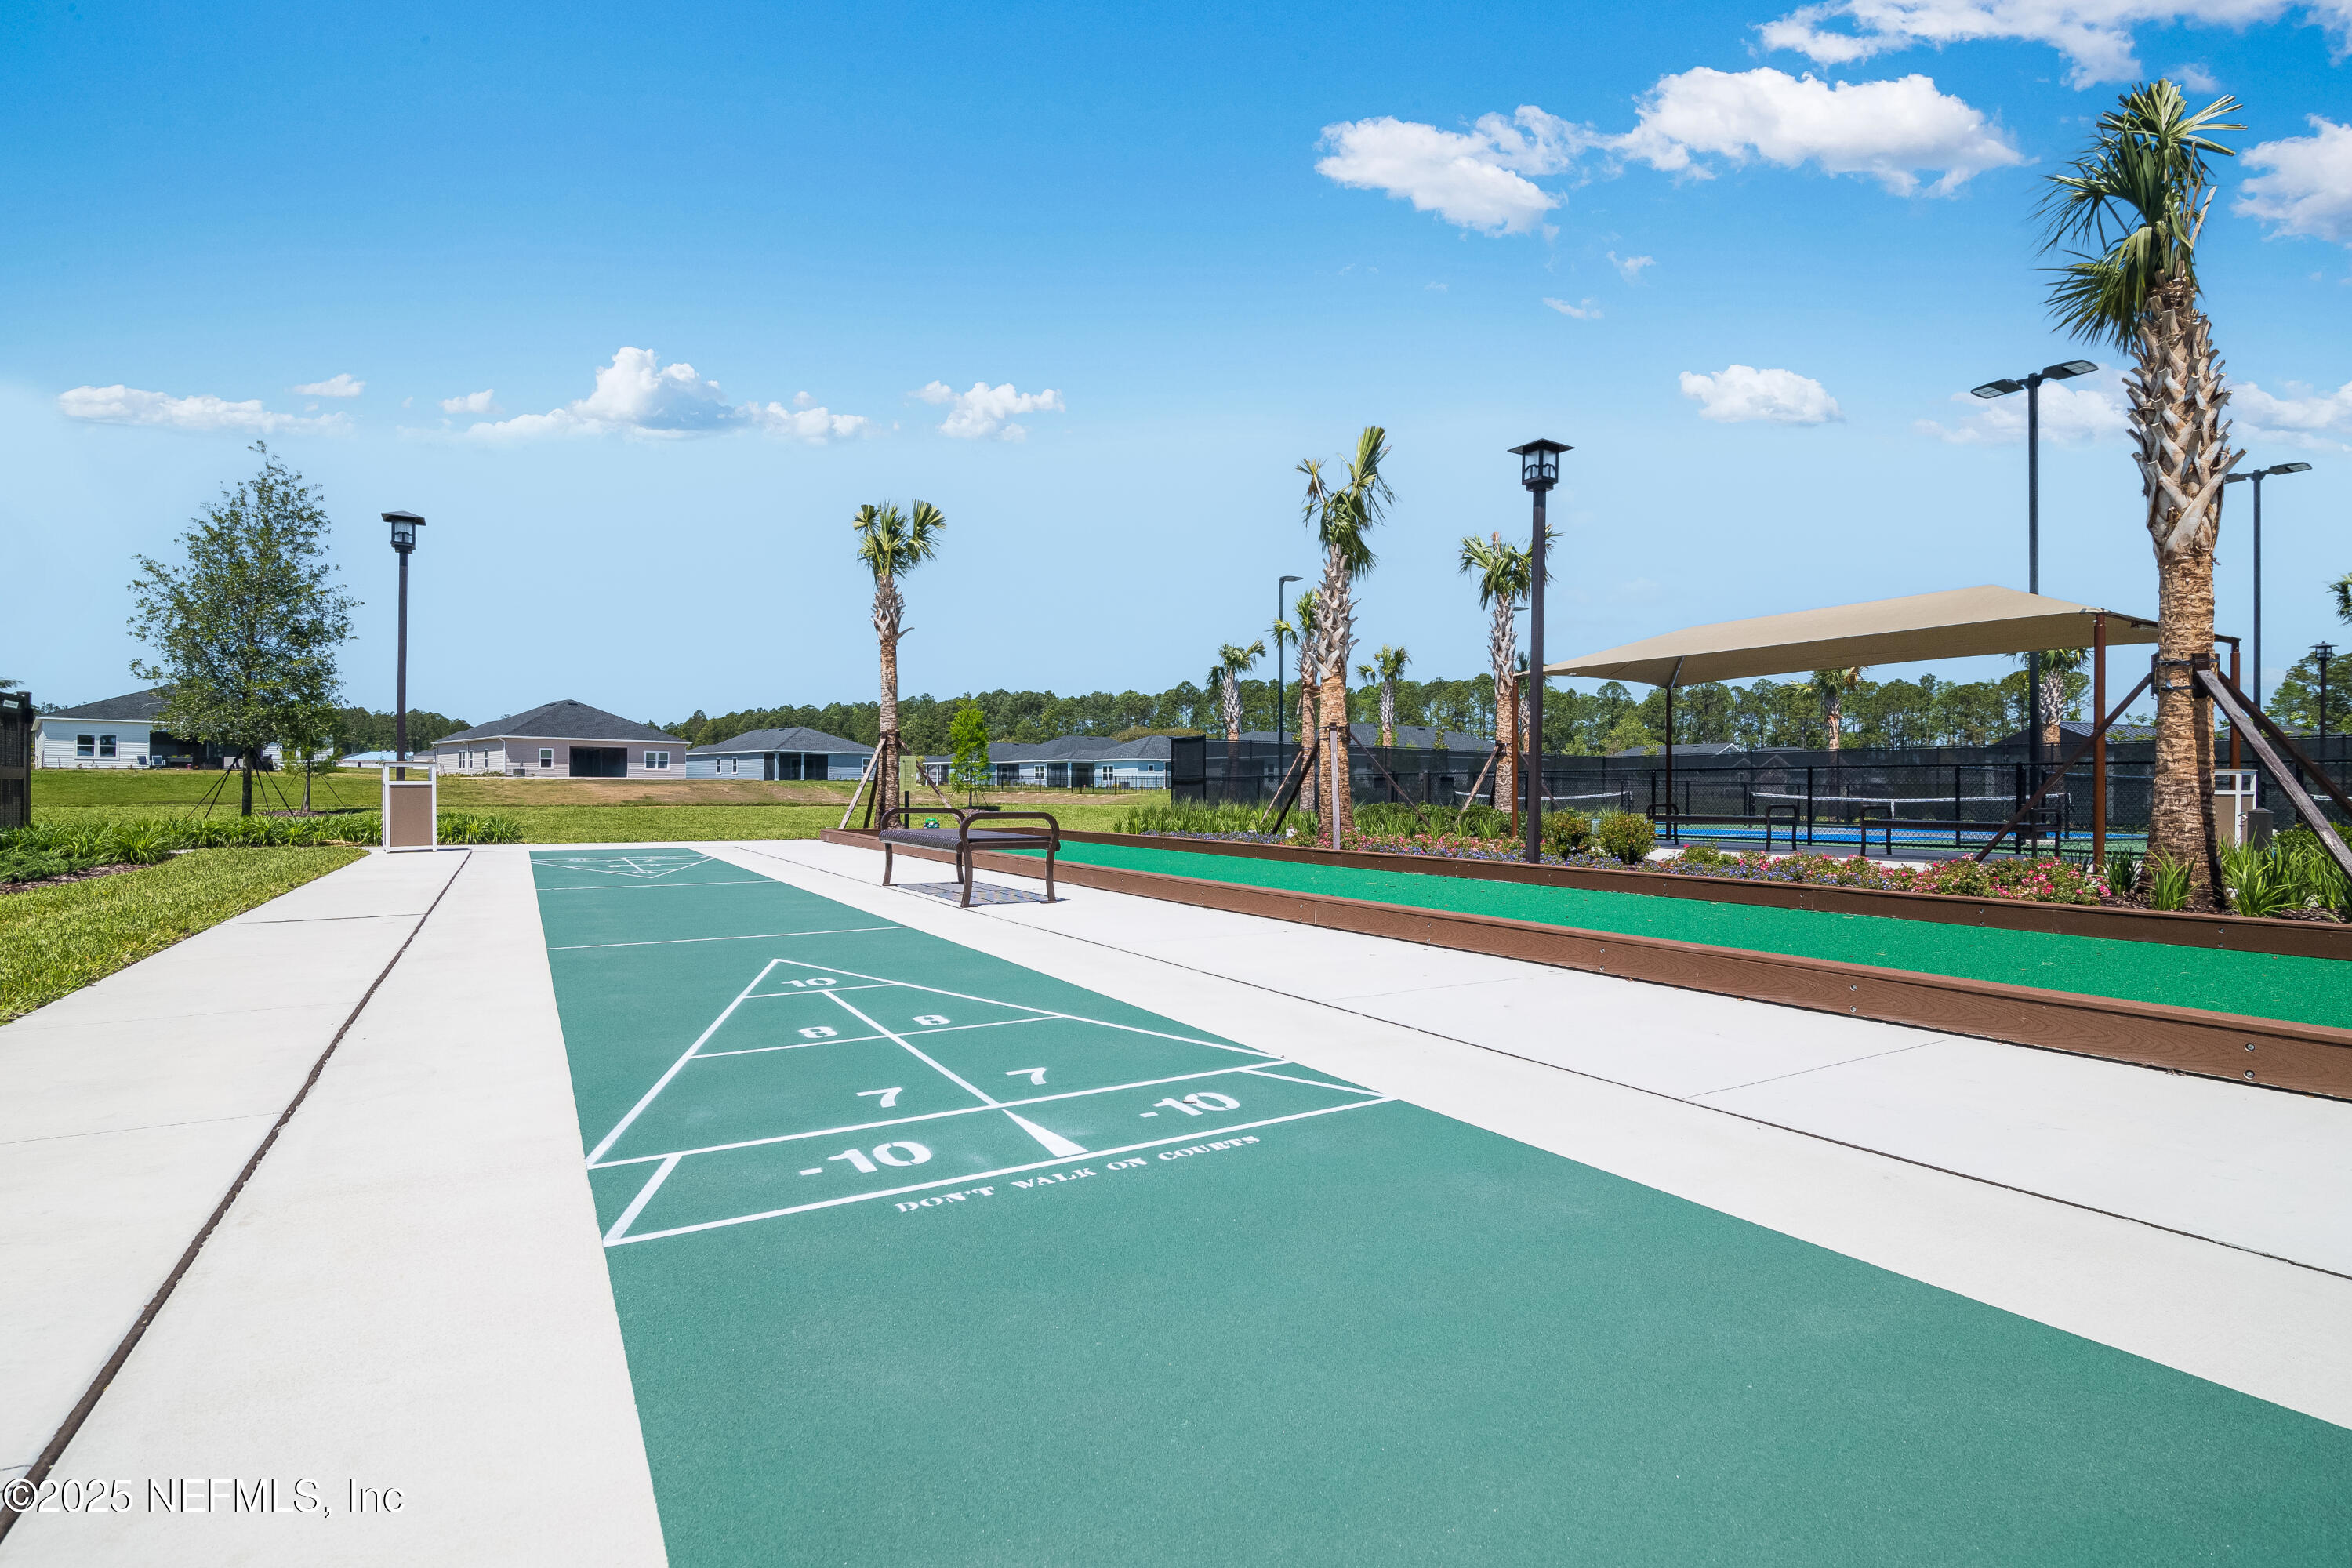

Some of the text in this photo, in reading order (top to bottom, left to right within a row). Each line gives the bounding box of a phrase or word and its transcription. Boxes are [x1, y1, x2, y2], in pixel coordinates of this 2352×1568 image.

[781, 977, 838, 988] 10
[912, 1014, 951, 1026] 8
[797, 1025, 839, 1039] 8
[1004, 1066, 1047, 1086] 7
[855, 1086, 903, 1109] 7
[1138, 1091, 1240, 1118] -10
[798, 1140, 934, 1177] -10
[894, 1135, 1261, 1213] DON'T WALK ON COURTS
